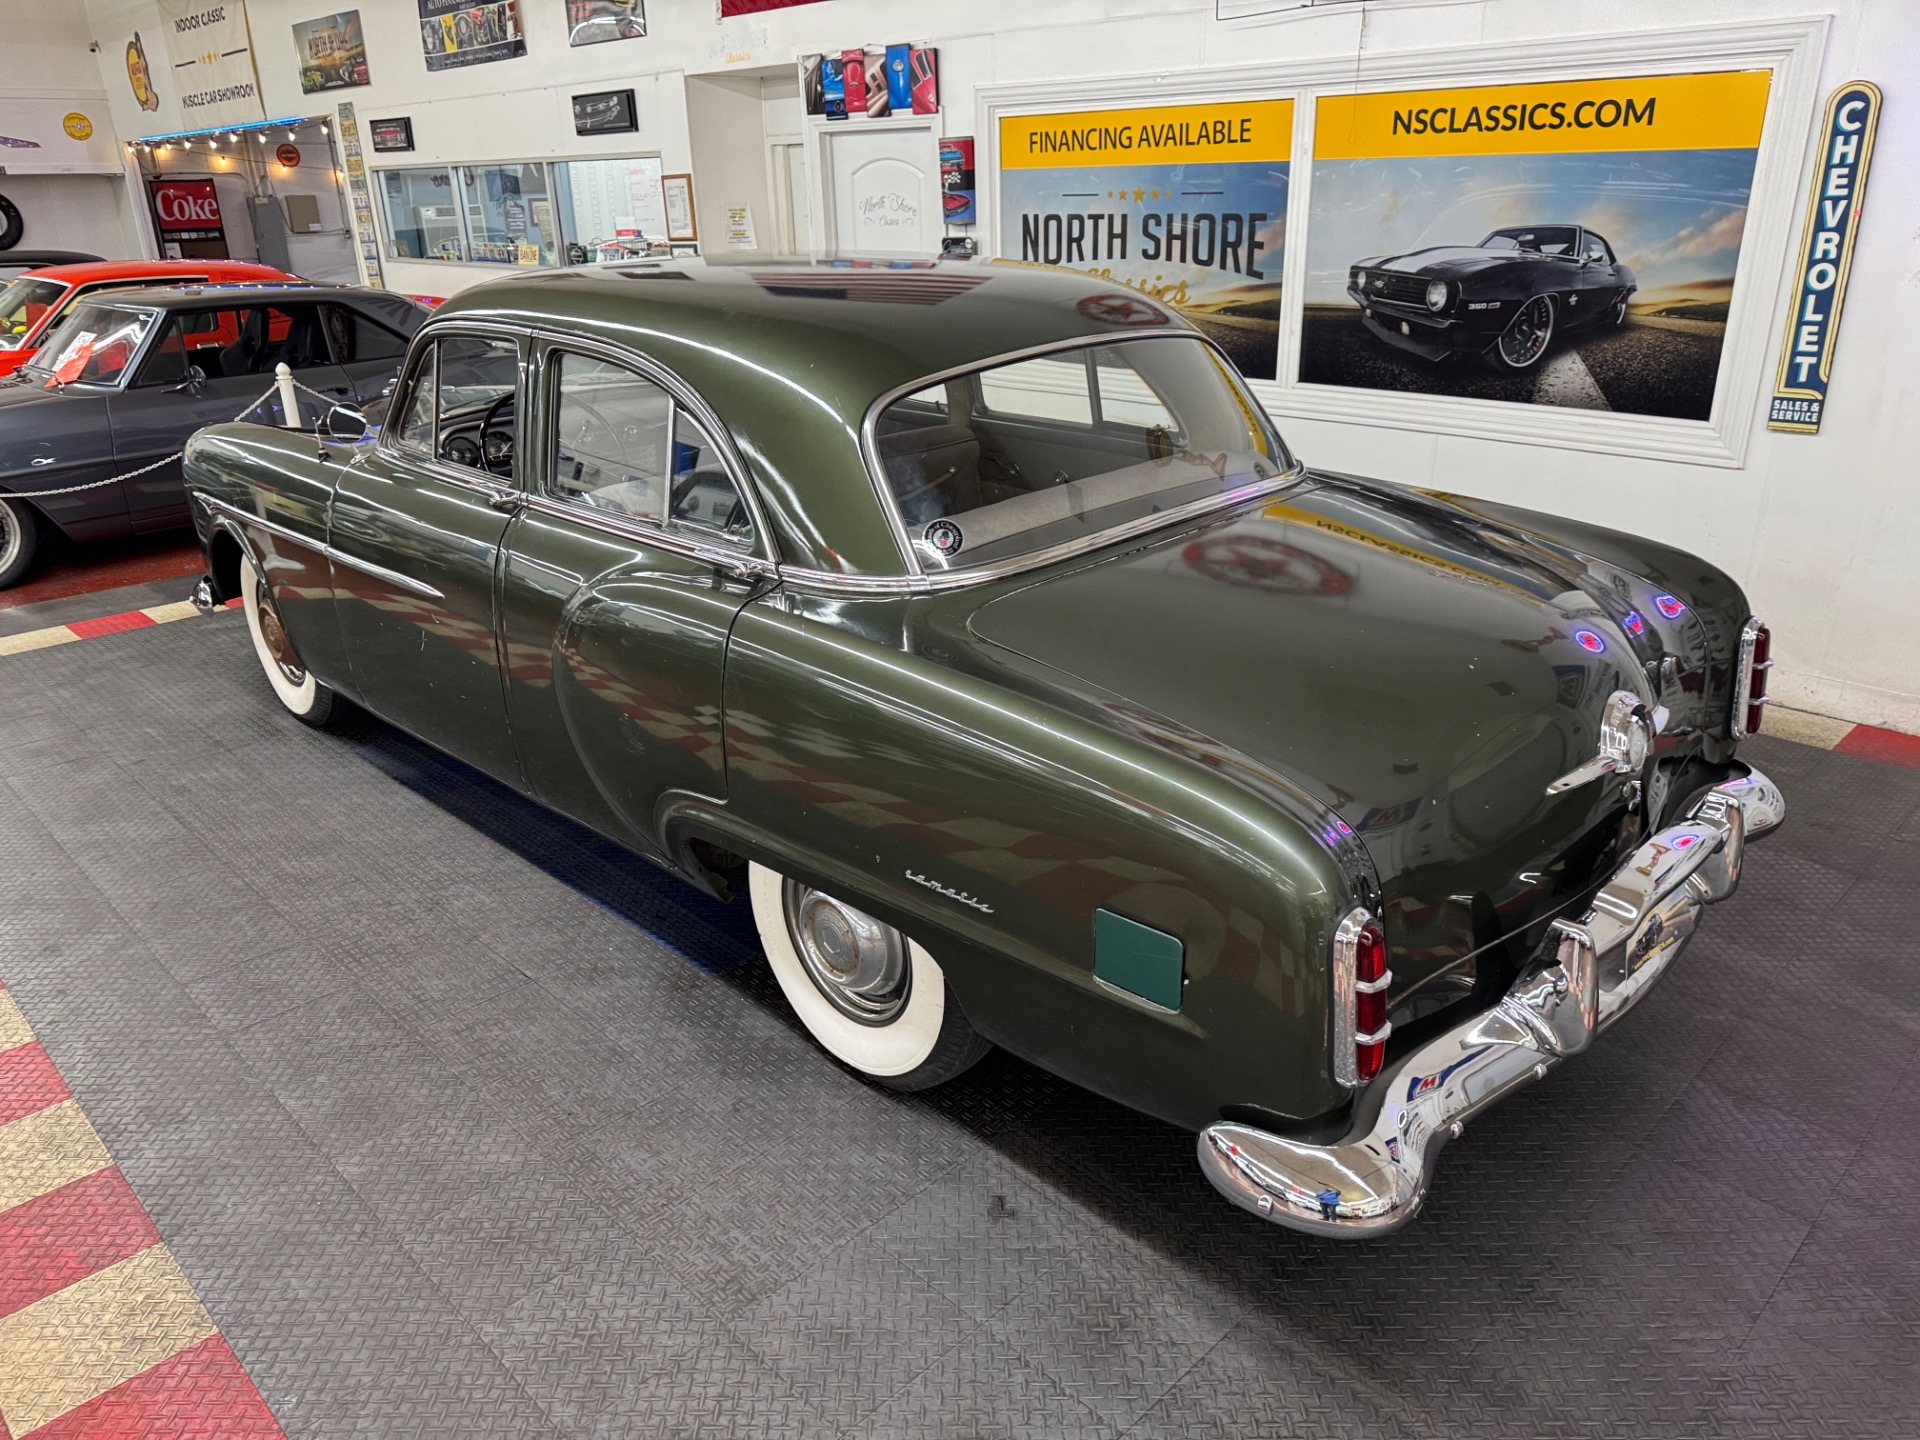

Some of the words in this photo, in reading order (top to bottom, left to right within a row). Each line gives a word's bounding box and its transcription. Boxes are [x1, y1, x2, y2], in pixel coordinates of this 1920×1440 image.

[174, 14, 201, 33] INDOOR
[200, 6, 226, 27] CLASSIC
[182, 92, 206, 109] MUSCLE
[205, 89, 219, 105] CAR
[217, 83, 255, 102] SHOWROOM
[1391, 97, 1657, 136] NSCLASSICS.COM
[1029, 126, 1133, 154] FINANCING
[1136, 118, 1252, 149] AVAILABLE
[155, 189, 219, 221] Coke
[1022, 213, 1128, 265] NORTH
[1141, 212, 1268, 280] SHORE
[1793, 100, 1866, 383] CHEVROLET
[1771, 410, 1818, 422] SERVICE
[1773, 399, 1808, 411] SALES
[1810, 402, 1820, 412] &
